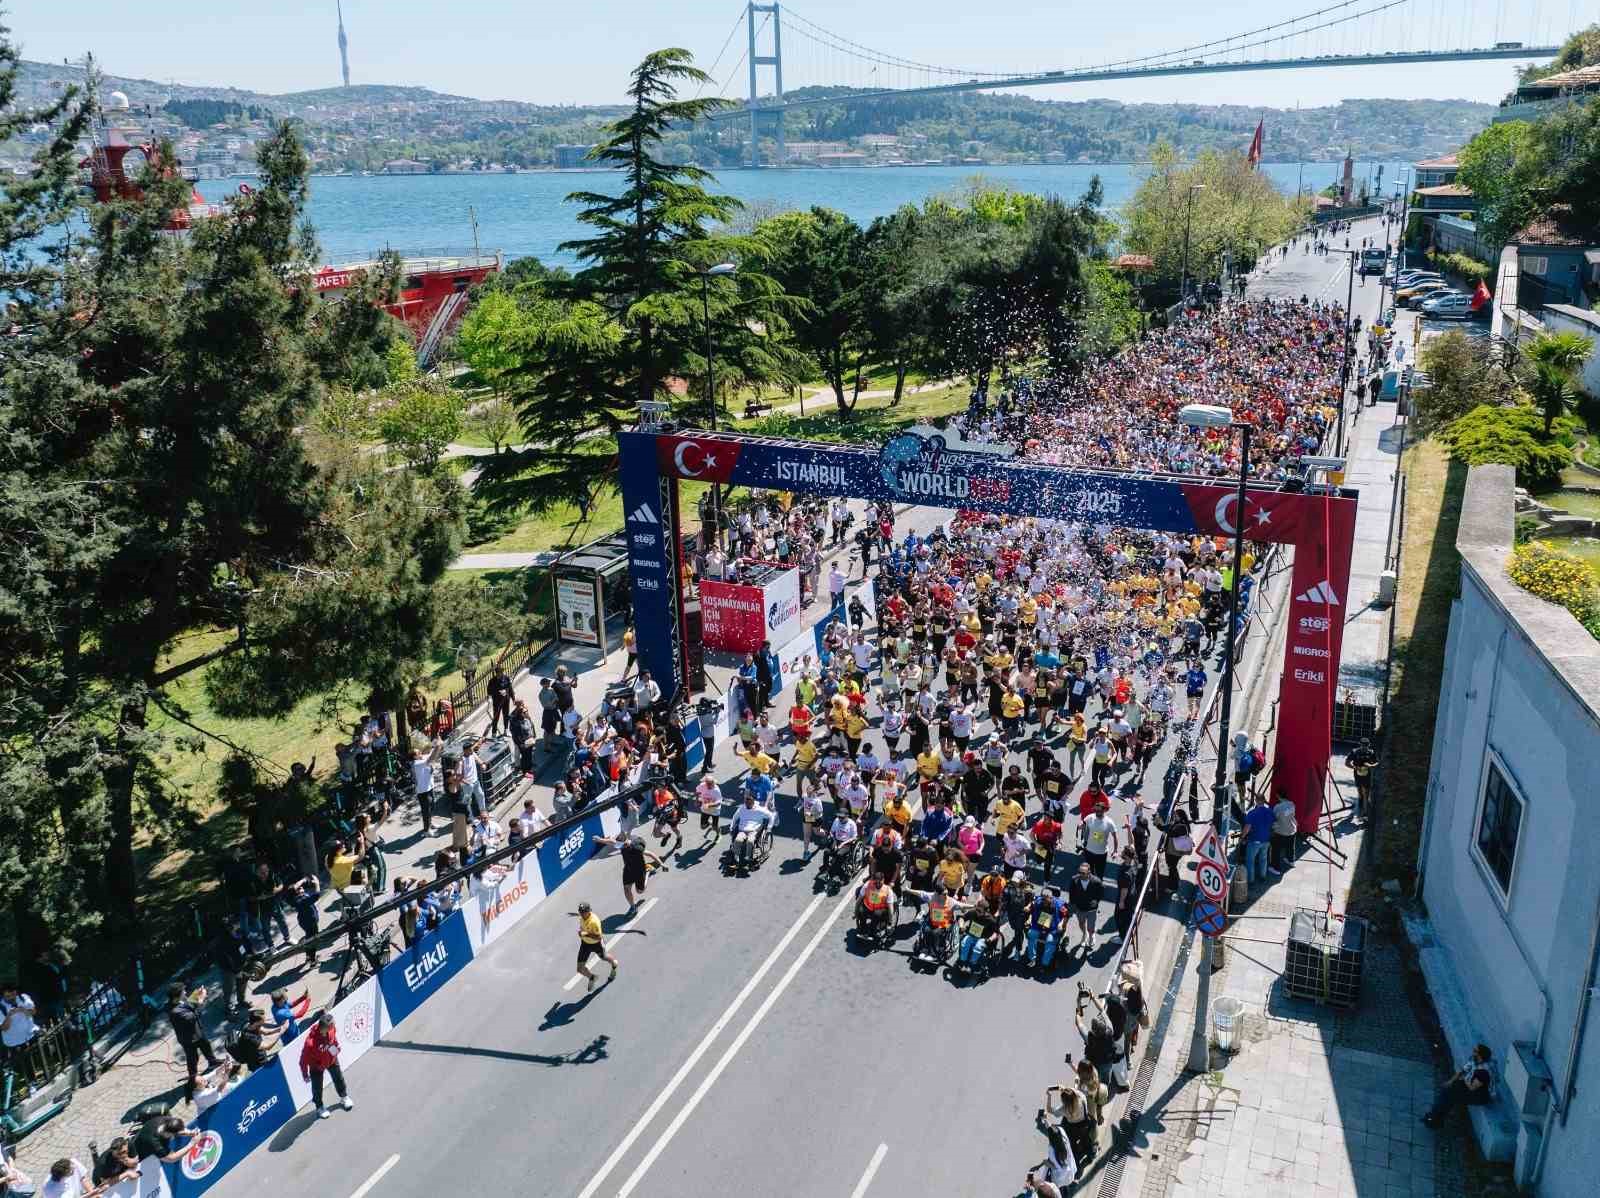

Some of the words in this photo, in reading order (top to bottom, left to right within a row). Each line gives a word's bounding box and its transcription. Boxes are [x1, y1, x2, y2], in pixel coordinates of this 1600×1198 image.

[312, 273, 353, 288] SAFETY
[777, 456, 849, 486] İSTANBUL
[901, 470, 968, 498] WORLD
[1295, 668, 1324, 682] Erikli
[1203, 869, 1221, 892] 30
[404, 940, 447, 988] Erikli
